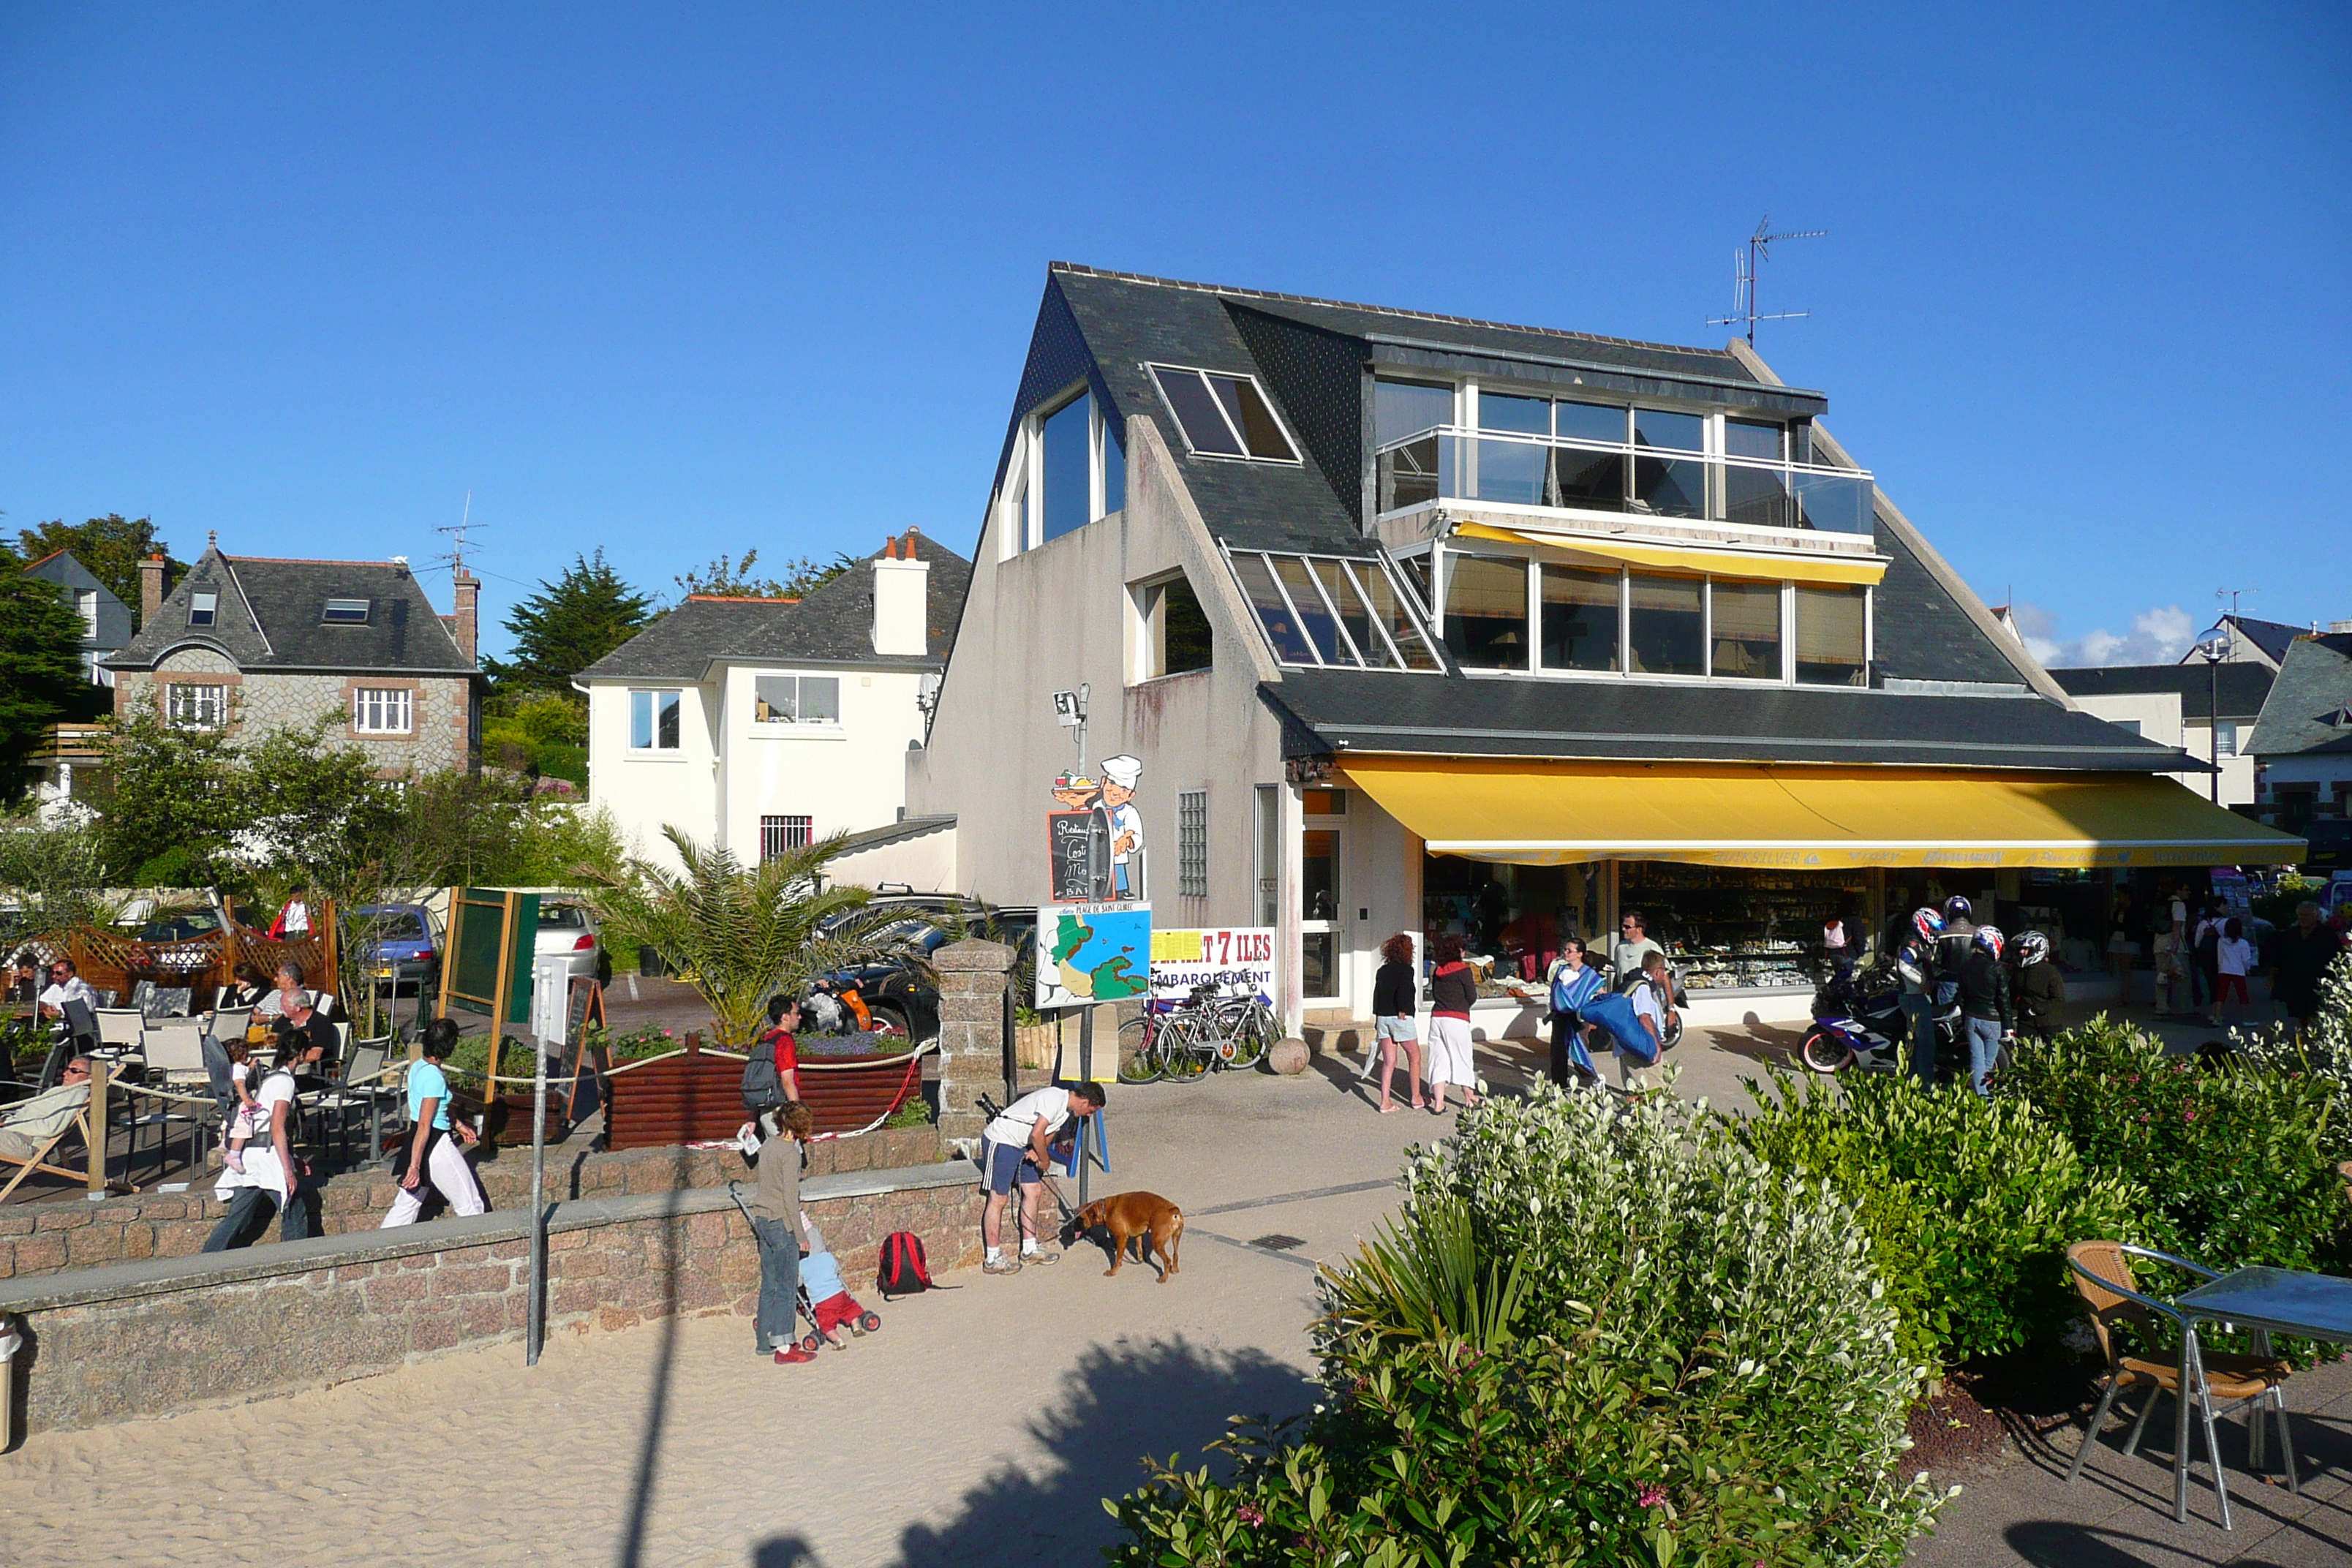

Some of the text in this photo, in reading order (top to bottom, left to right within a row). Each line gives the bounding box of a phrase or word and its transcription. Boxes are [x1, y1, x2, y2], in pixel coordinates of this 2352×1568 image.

[1064, 862, 1088, 878] Mo
[1218, 931, 1231, 965] 7
[1237, 934, 1271, 962] ILES
